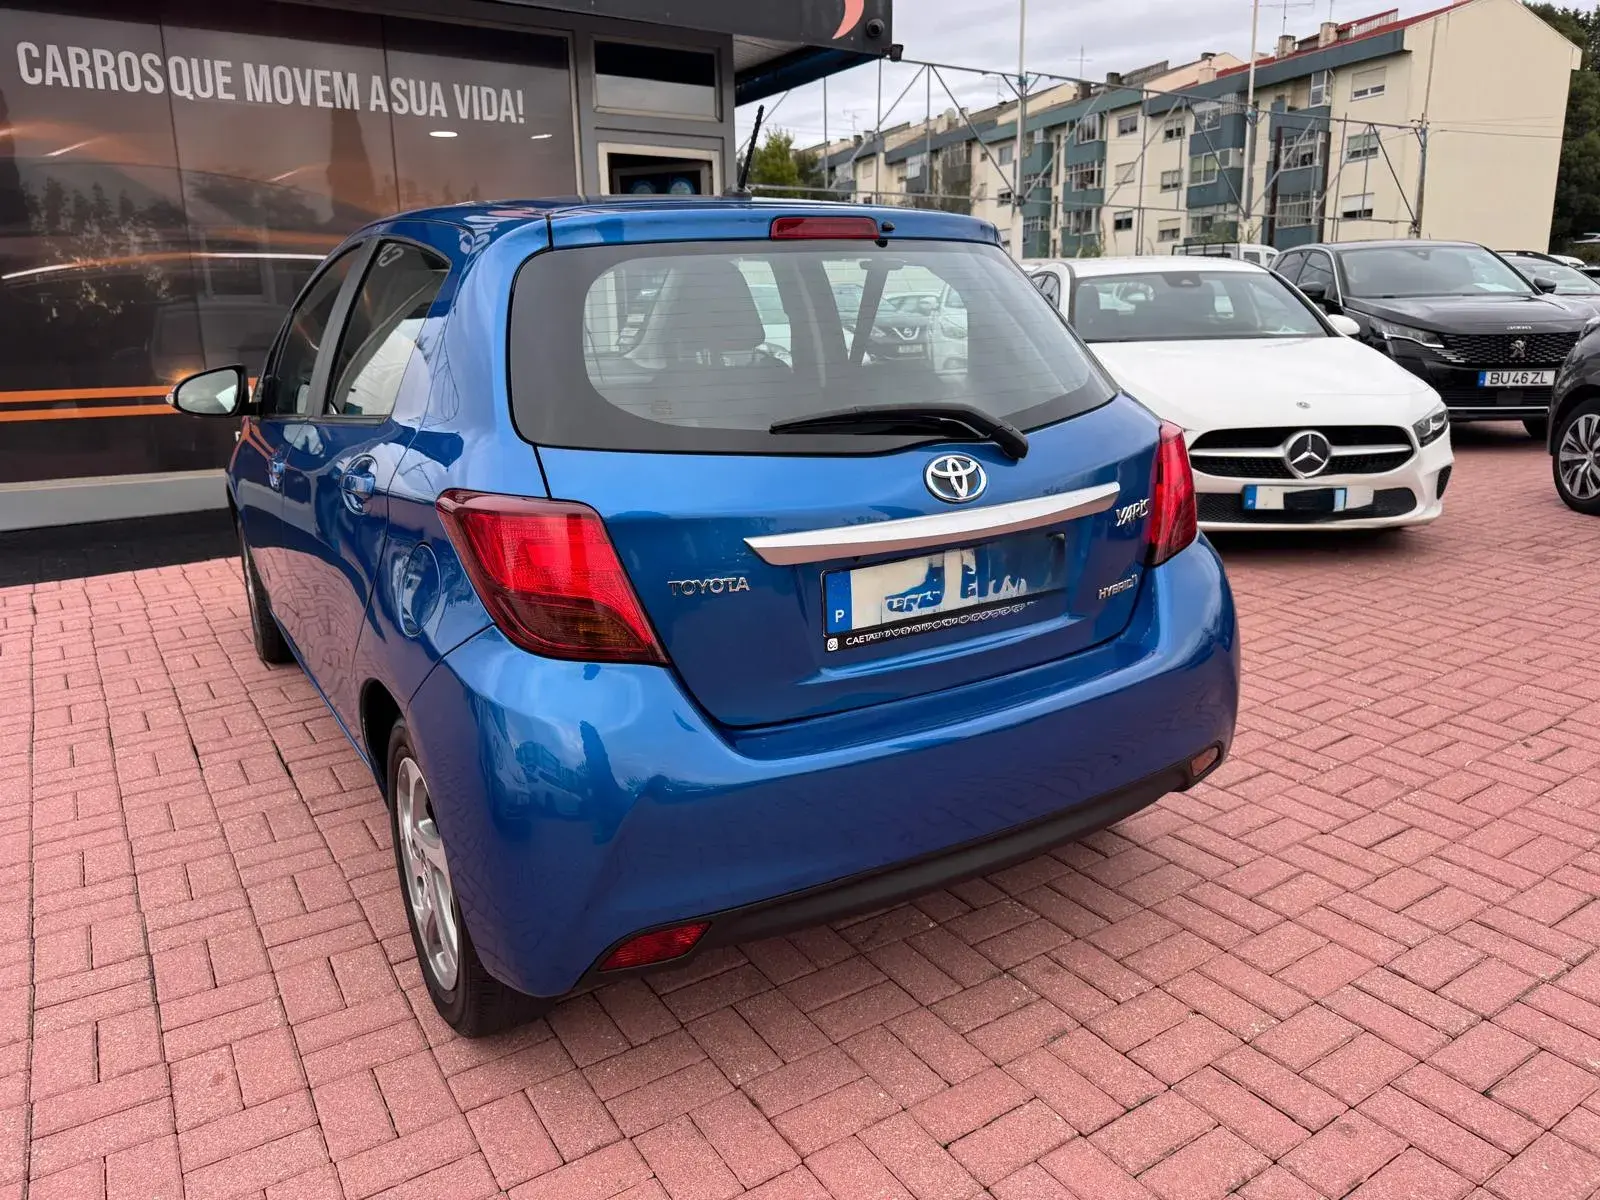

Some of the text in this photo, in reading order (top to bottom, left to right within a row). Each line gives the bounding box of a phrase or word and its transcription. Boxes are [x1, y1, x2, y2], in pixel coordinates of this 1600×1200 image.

[16, 41, 525, 124] CARROS QUE MOVEM A SUA VIDA!
[1489, 372, 1511, 385] BU
[1511, 372, 1529, 385] 46
[1530, 372, 1548, 385] ZL
[667, 576, 751, 596] TOYOTA
[835, 609, 845, 623] P
